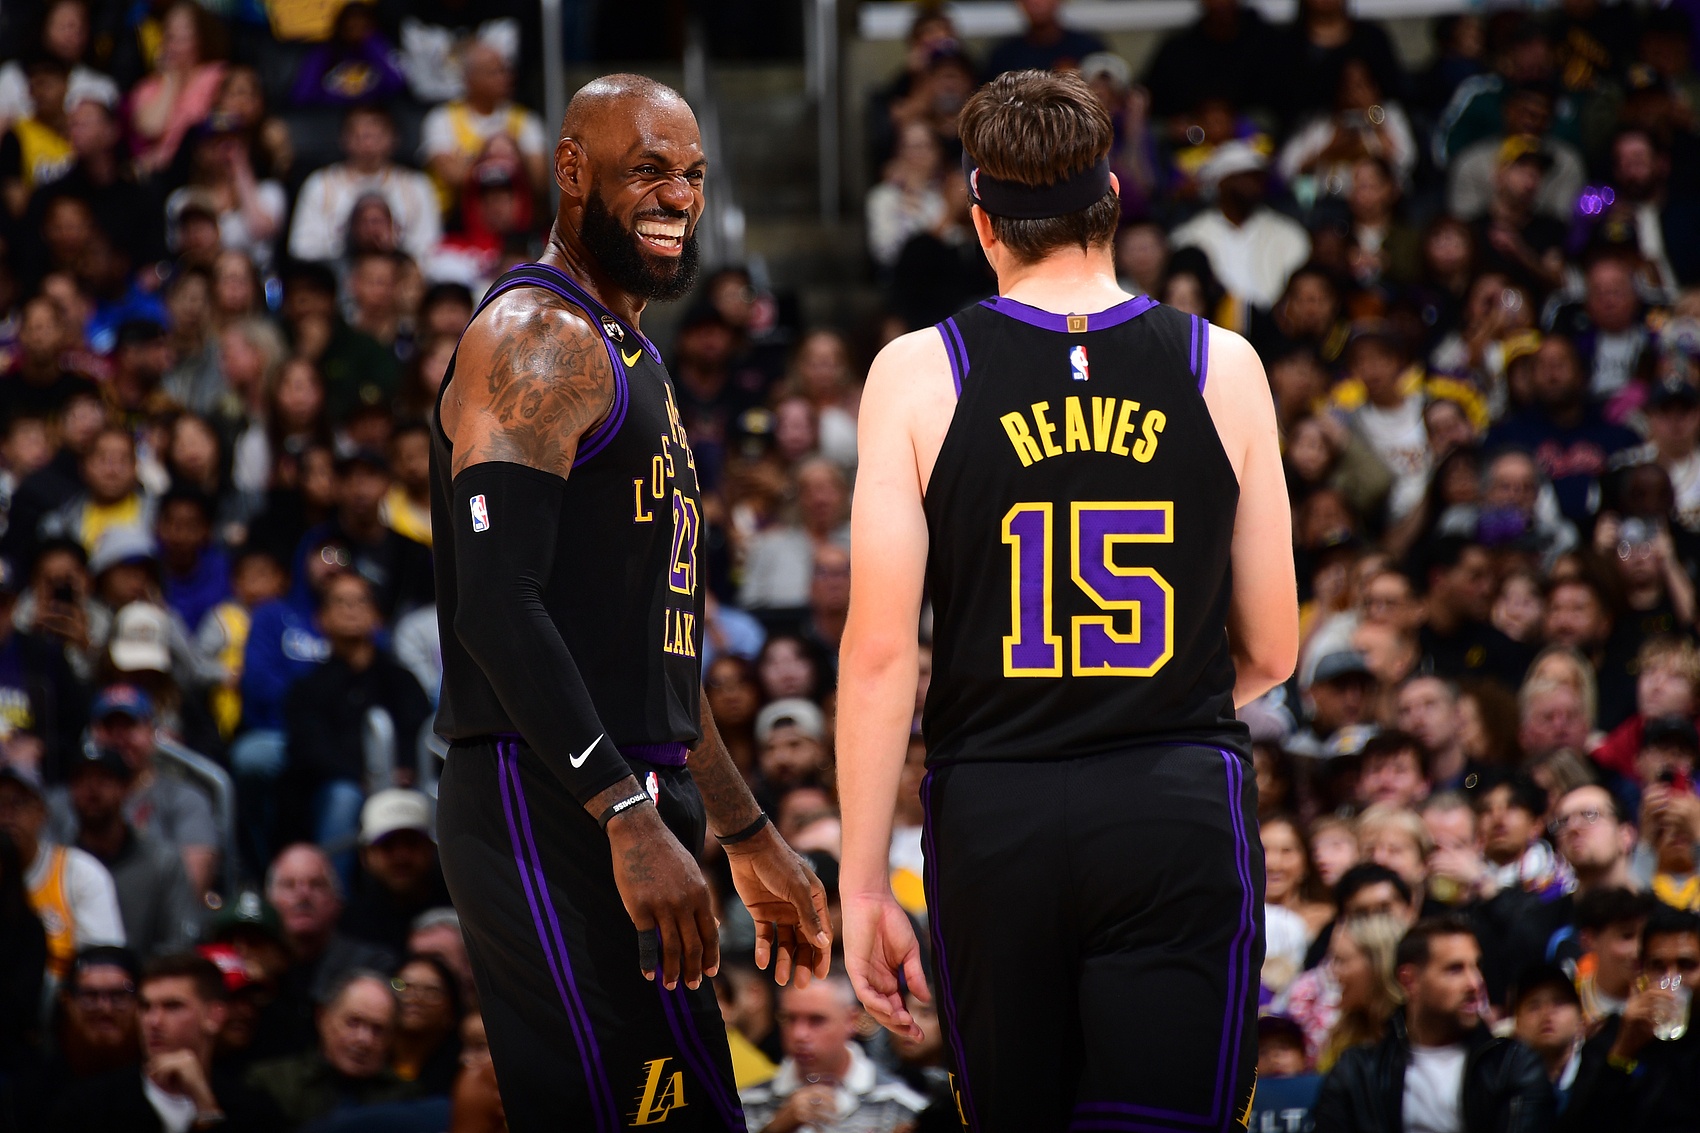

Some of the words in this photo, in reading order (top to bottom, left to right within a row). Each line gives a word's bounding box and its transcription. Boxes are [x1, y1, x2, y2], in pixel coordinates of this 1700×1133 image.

[1000, 396, 1167, 468] REAVES
[633, 434, 675, 522] LOS
[1001, 501, 1174, 678] 15
[663, 608, 696, 658] LAK
[612, 794, 643, 812] PROMISE
[626, 1057, 689, 1126] LA
